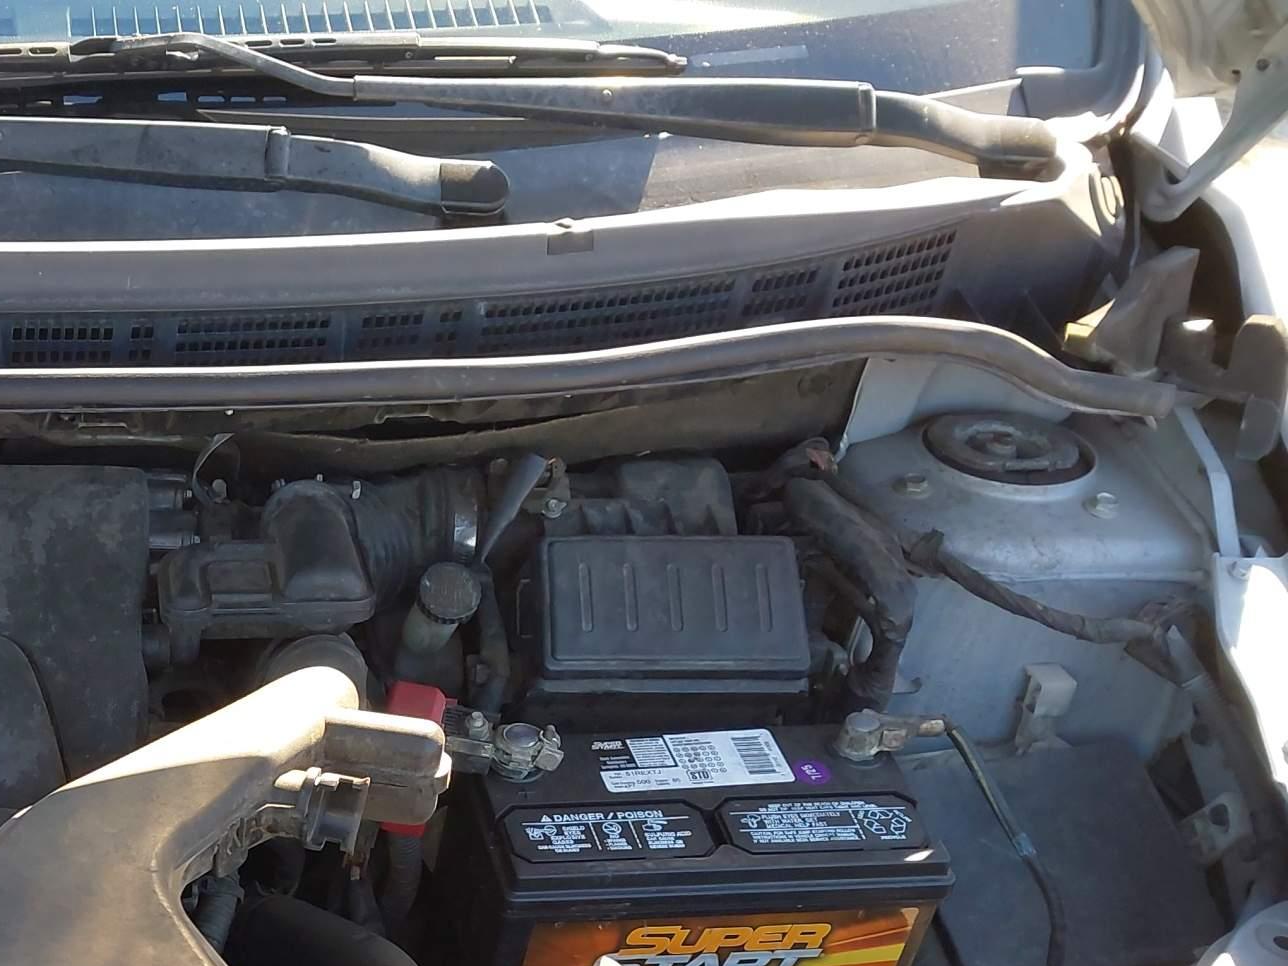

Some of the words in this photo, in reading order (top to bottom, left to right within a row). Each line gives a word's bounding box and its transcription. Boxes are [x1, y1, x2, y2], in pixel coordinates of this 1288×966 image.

[553, 812, 605, 822] DANGER
[616, 810, 663, 819] POISON
[615, 922, 832, 956] SUPER
